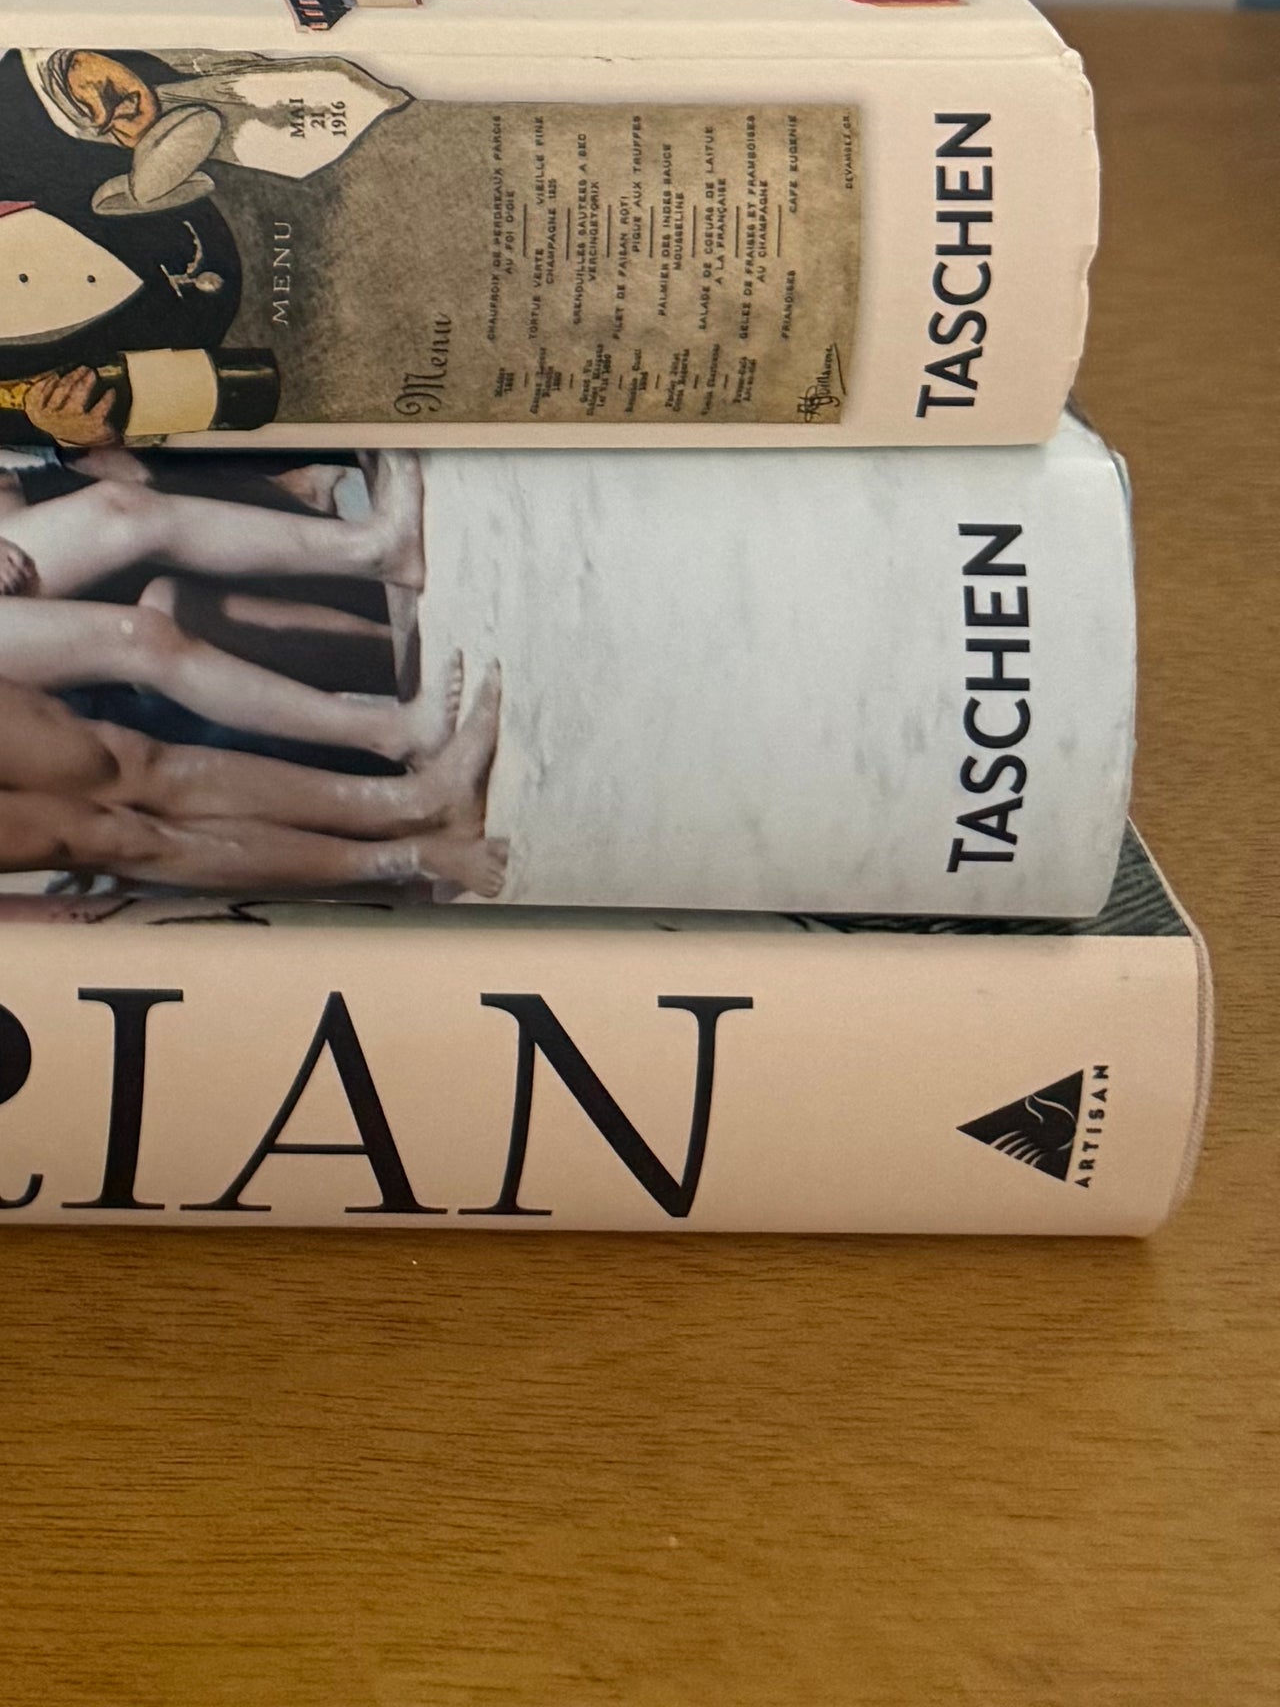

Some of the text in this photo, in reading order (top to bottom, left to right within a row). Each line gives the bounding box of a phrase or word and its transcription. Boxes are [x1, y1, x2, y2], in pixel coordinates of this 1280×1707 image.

[290, 98, 305, 138] MAI
[311, 112, 326, 129] 21
[332, 101, 347, 136] 1916
[632, 182, 641, 207] AUX
[705, 183, 714, 198] DE
[492, 252, 501, 267] DE
[545, 209, 556, 284] CHAMPAGNE
[273, 221, 292, 326] MENU
[504, 259, 513, 274] AU
[534, 249, 543, 287] VERTE
[703, 263, 712, 278] DE
[756, 266, 766, 283] AU
[915, 112, 992, 418] TASCHEN
[616, 285, 625, 299] DE
[743, 281, 753, 296] DE
[529, 296, 541, 339] TORTUE
[393, 313, 452, 416] Menu
[945, 523, 1031, 873] TASCHEN
[1074, 1066, 1109, 1188] ARTISAN
